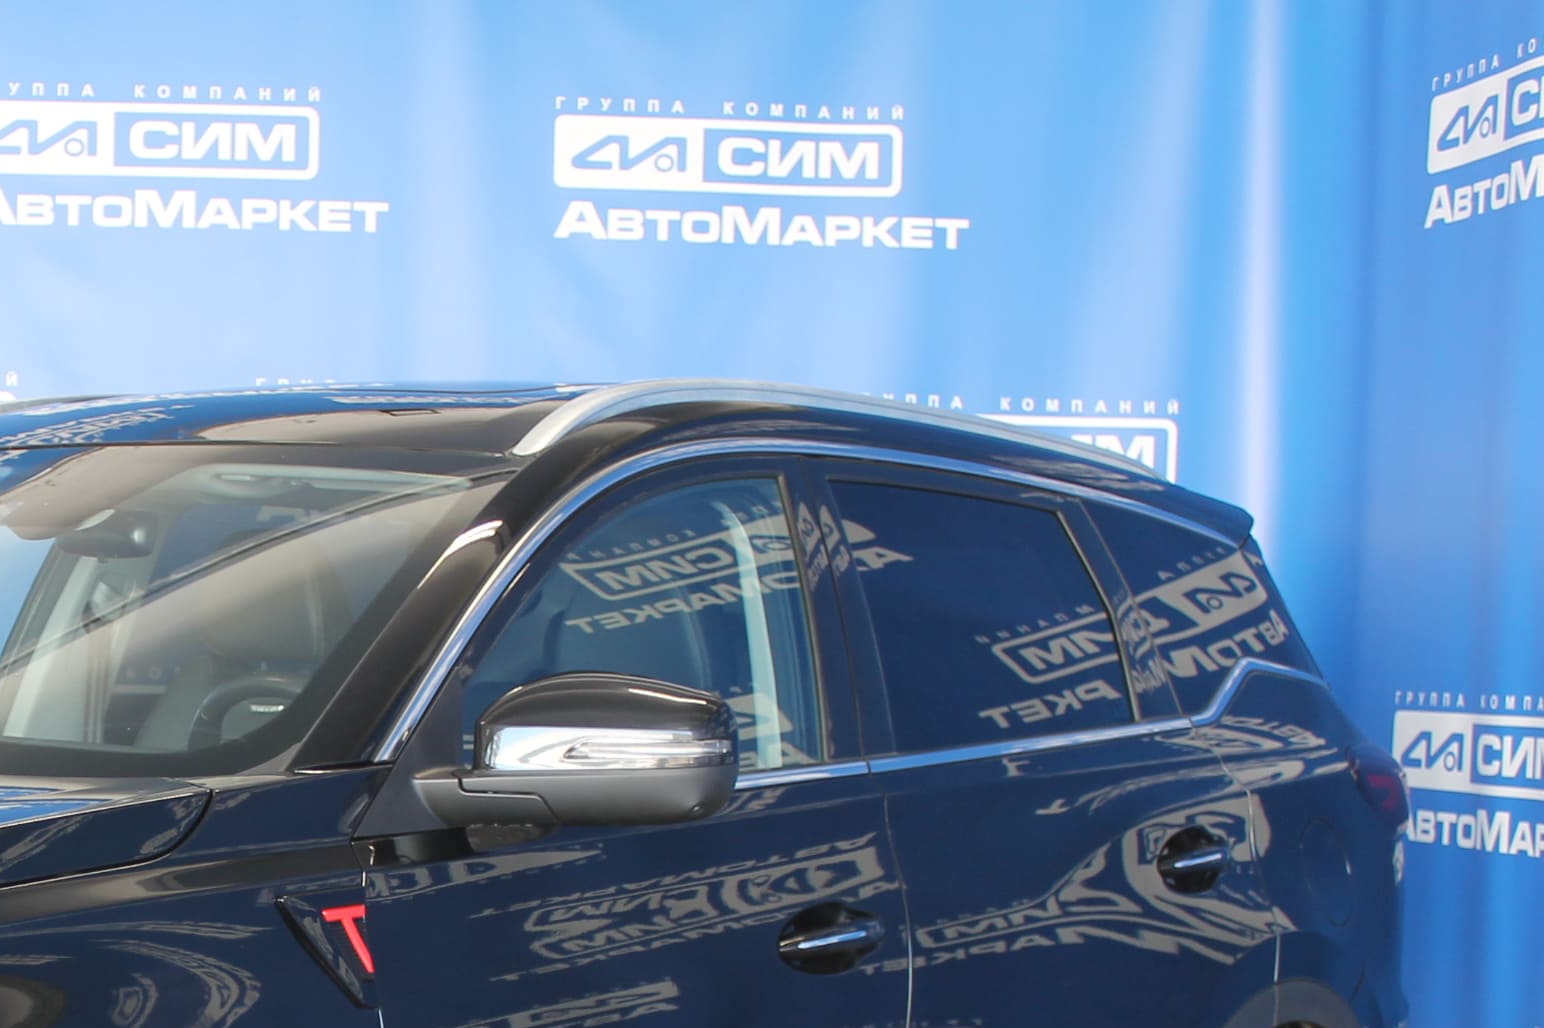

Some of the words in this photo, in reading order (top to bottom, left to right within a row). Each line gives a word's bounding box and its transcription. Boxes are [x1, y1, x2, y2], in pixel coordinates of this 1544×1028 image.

[1431, 55, 1499, 91] ГРУППА
[135, 85, 320, 102] КОМПАНИЙ
[556, 96, 684, 114] ГРУППА
[723, 101, 904, 120] КОМПАНИЙ
[130, 120, 296, 162] СИМ
[718, 137, 879, 180] СИМ
[1001, 398, 1179, 415] КОМПАНИЙ
[1394, 690, 1465, 708] ГРУППА
[1476, 734, 1544, 780] СИ
